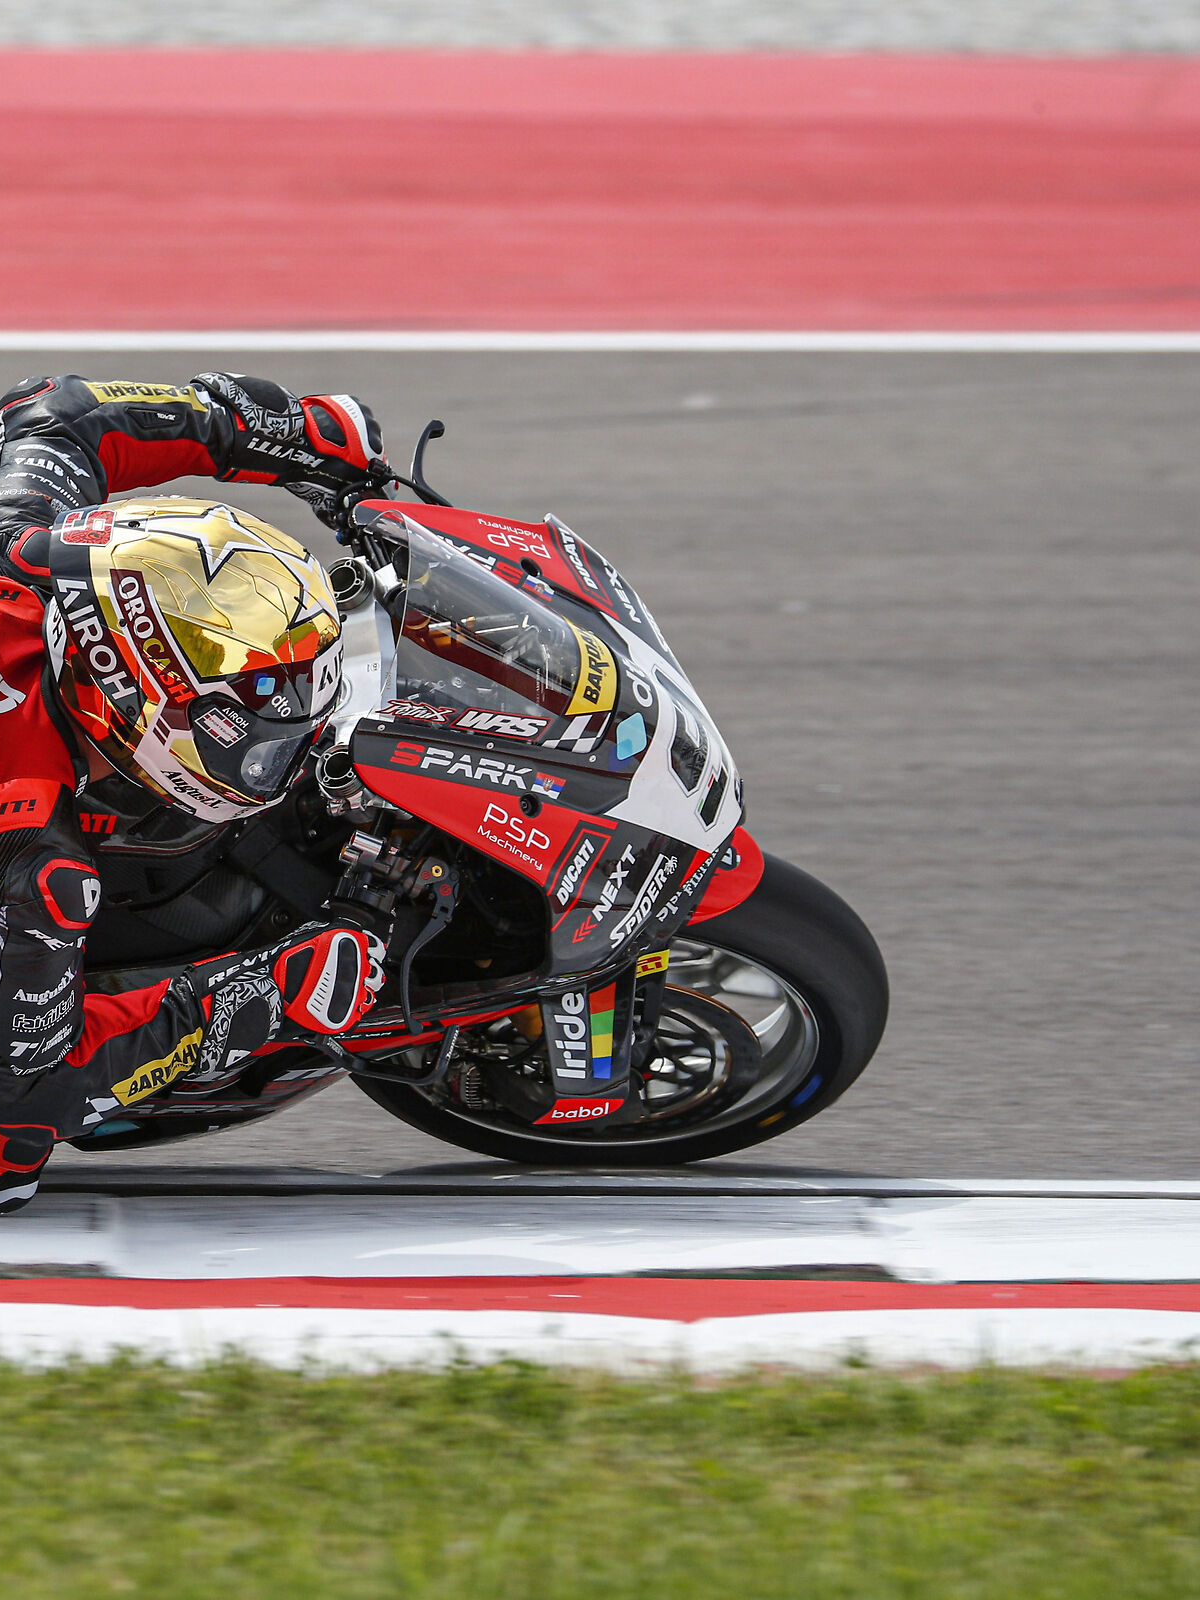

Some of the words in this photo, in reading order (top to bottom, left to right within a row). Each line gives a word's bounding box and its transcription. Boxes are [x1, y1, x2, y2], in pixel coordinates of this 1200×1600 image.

[477, 518, 544, 542] Machinery
[487, 532, 551, 559] PSP
[559, 527, 598, 590] DUCATI
[601, 559, 641, 624] NEX
[56, 578, 138, 700] AIROH
[118, 576, 196, 703] OROCASH
[583, 629, 611, 705] BARDA
[222, 707, 249, 729] AIROH
[271, 695, 292, 718] dto
[456, 711, 547, 737] WRS
[390, 742, 533, 790] SPARK
[477, 825, 543, 871] Machinery
[483, 803, 551, 850] PSP
[557, 839, 595, 906] DUCATI
[592, 843, 637, 922] NEXT
[609, 854, 668, 949] SPIDER
[551, 1102, 609, 1119] babol
